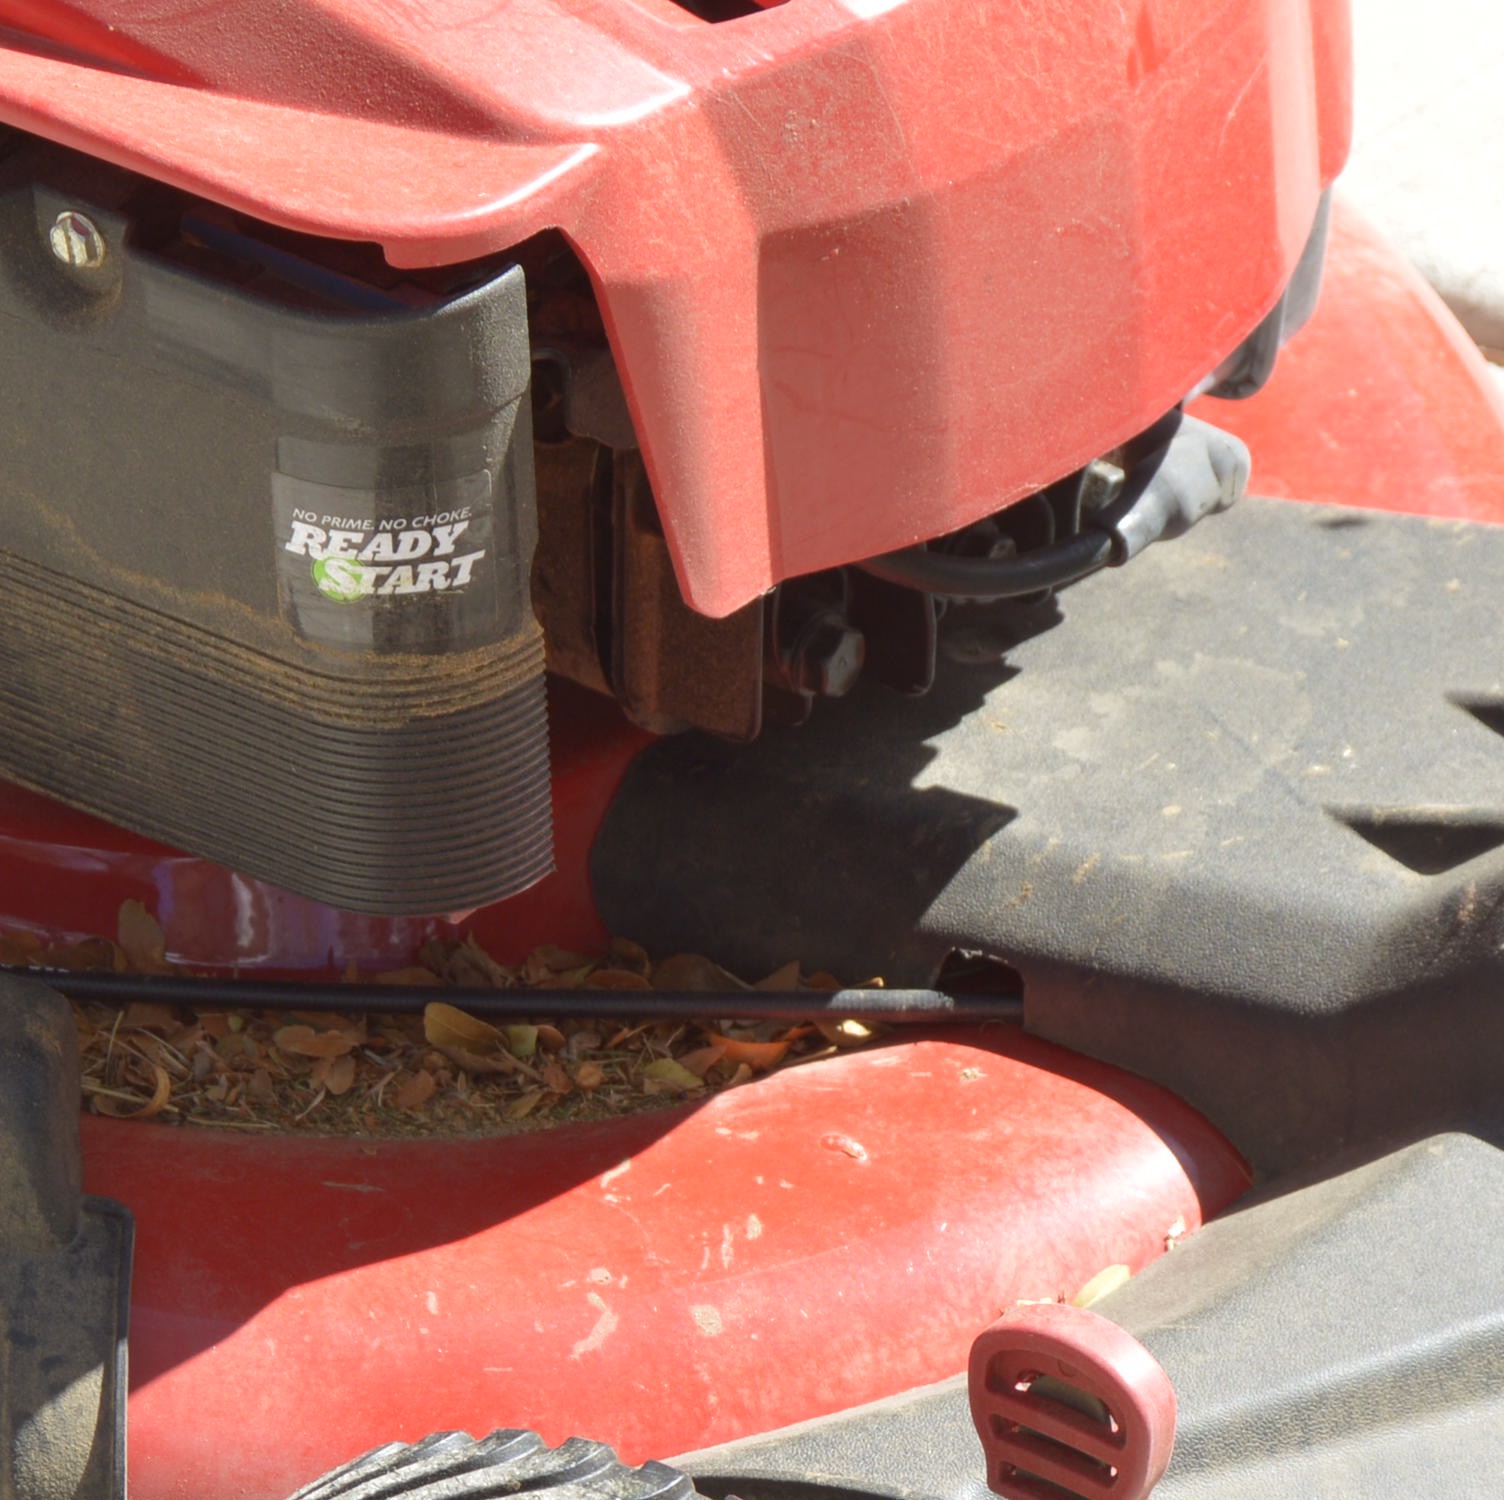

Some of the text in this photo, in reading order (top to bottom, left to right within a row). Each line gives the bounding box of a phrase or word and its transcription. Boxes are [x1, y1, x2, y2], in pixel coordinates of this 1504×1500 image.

[292, 506, 472, 531] NO PRIME. NO CHOKE.
[284, 521, 470, 561] READY
[318, 549, 487, 596] START
